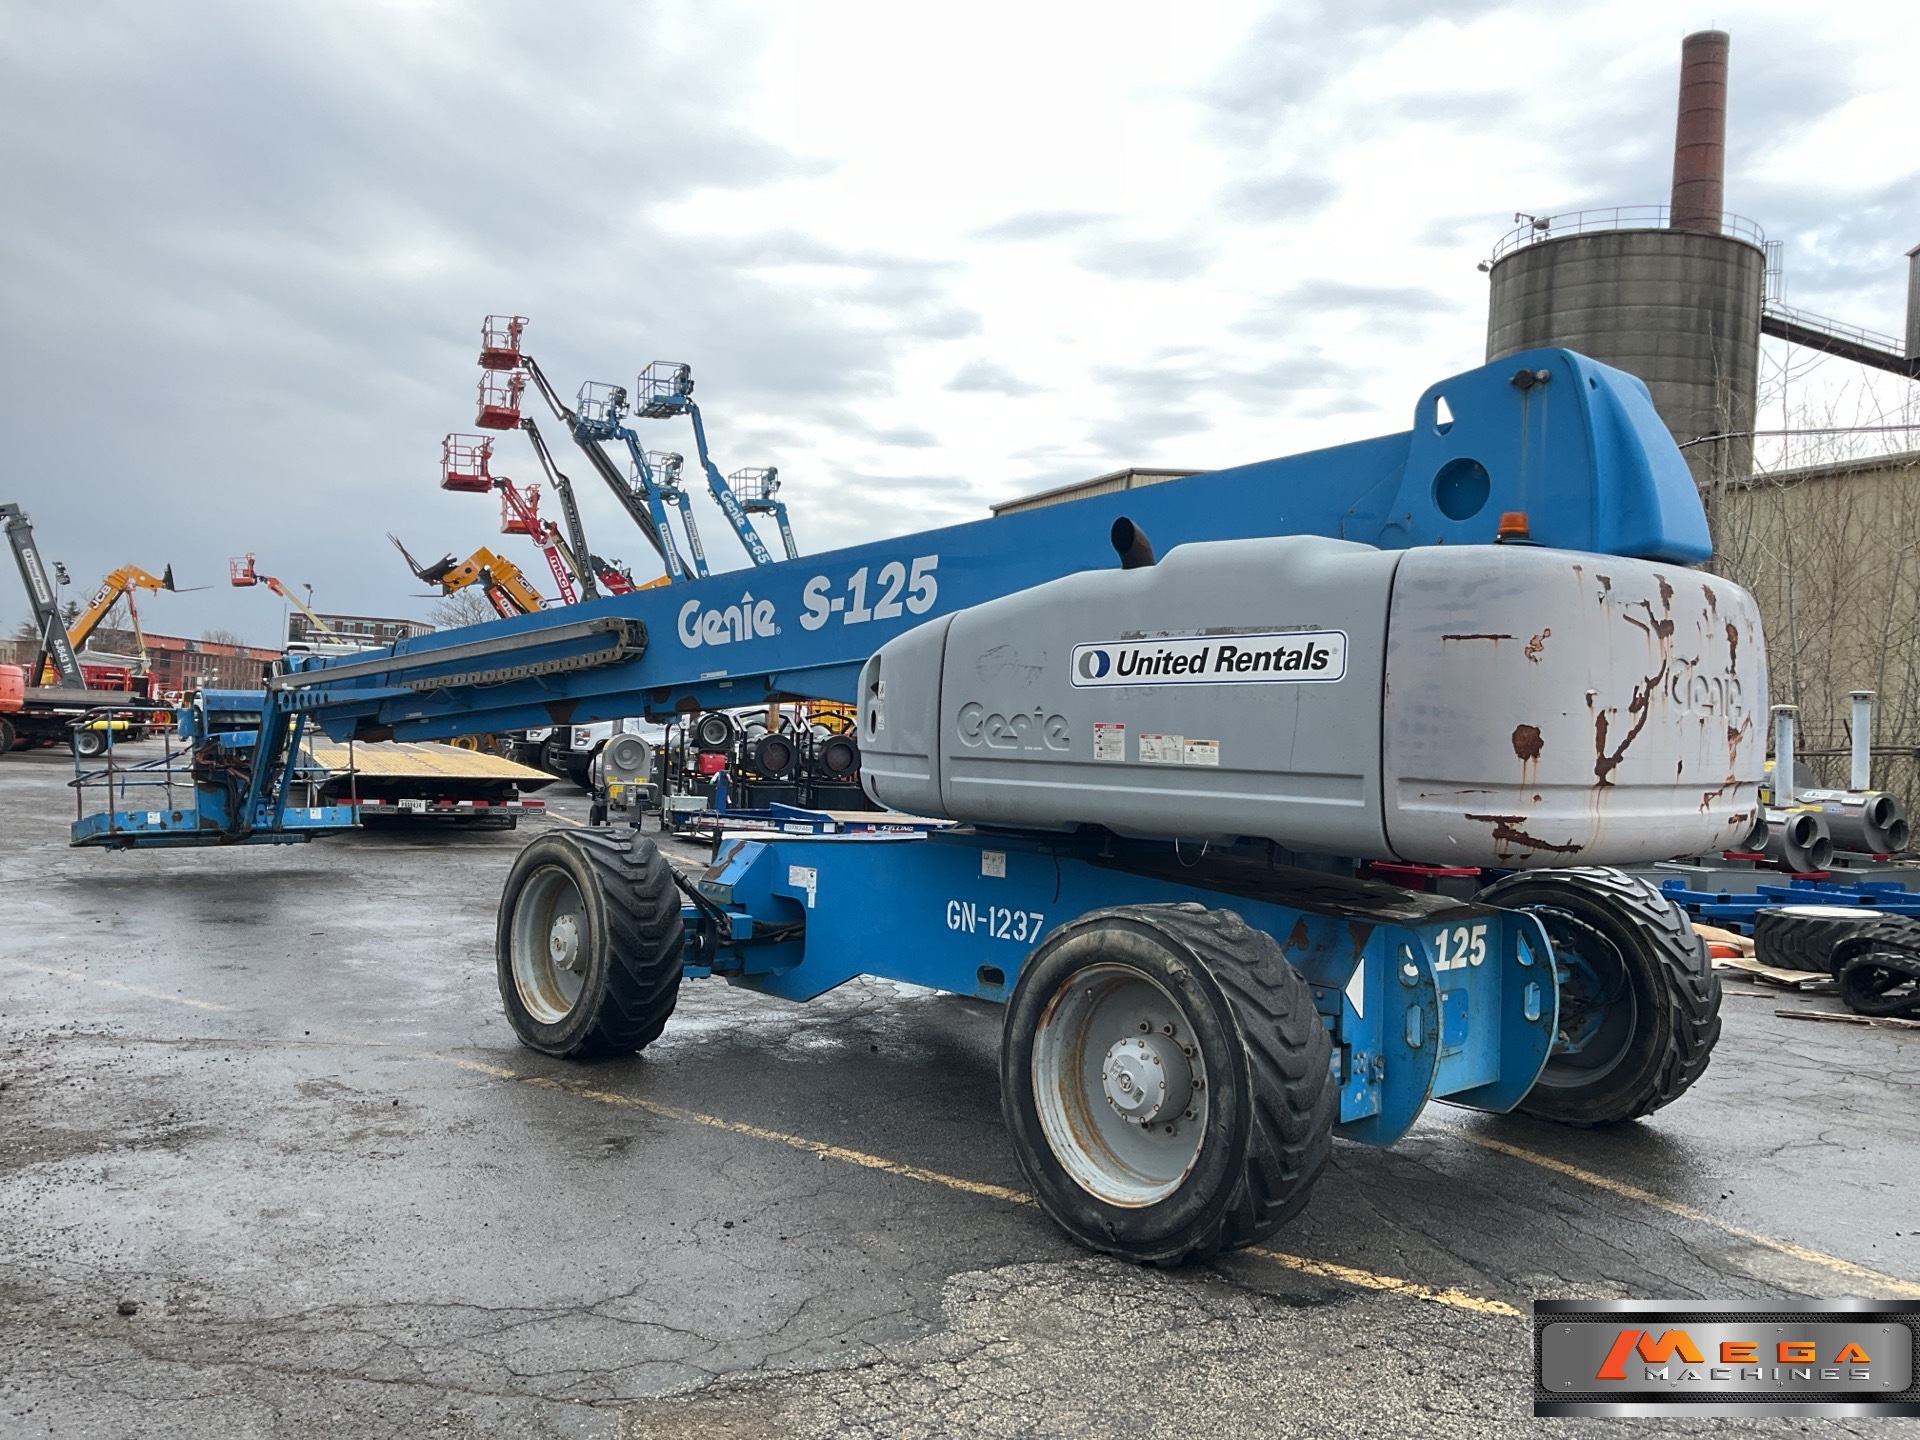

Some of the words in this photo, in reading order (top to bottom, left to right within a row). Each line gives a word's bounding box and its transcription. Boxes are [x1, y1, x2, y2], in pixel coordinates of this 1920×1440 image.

[720, 490, 745, 527] Genie
[744, 531, 771, 564] S-65
[515, 574, 534, 594] JCB
[550, 555, 569, 588] mec
[93, 584, 112, 609] JCB
[678, 591, 775, 649] Genie
[799, 554, 939, 631] S-125
[1117, 647, 1209, 676] United
[1214, 642, 1329, 672] Rentals
[957, 701, 1070, 751] Genie
[946, 900, 1044, 944] GN-1237
